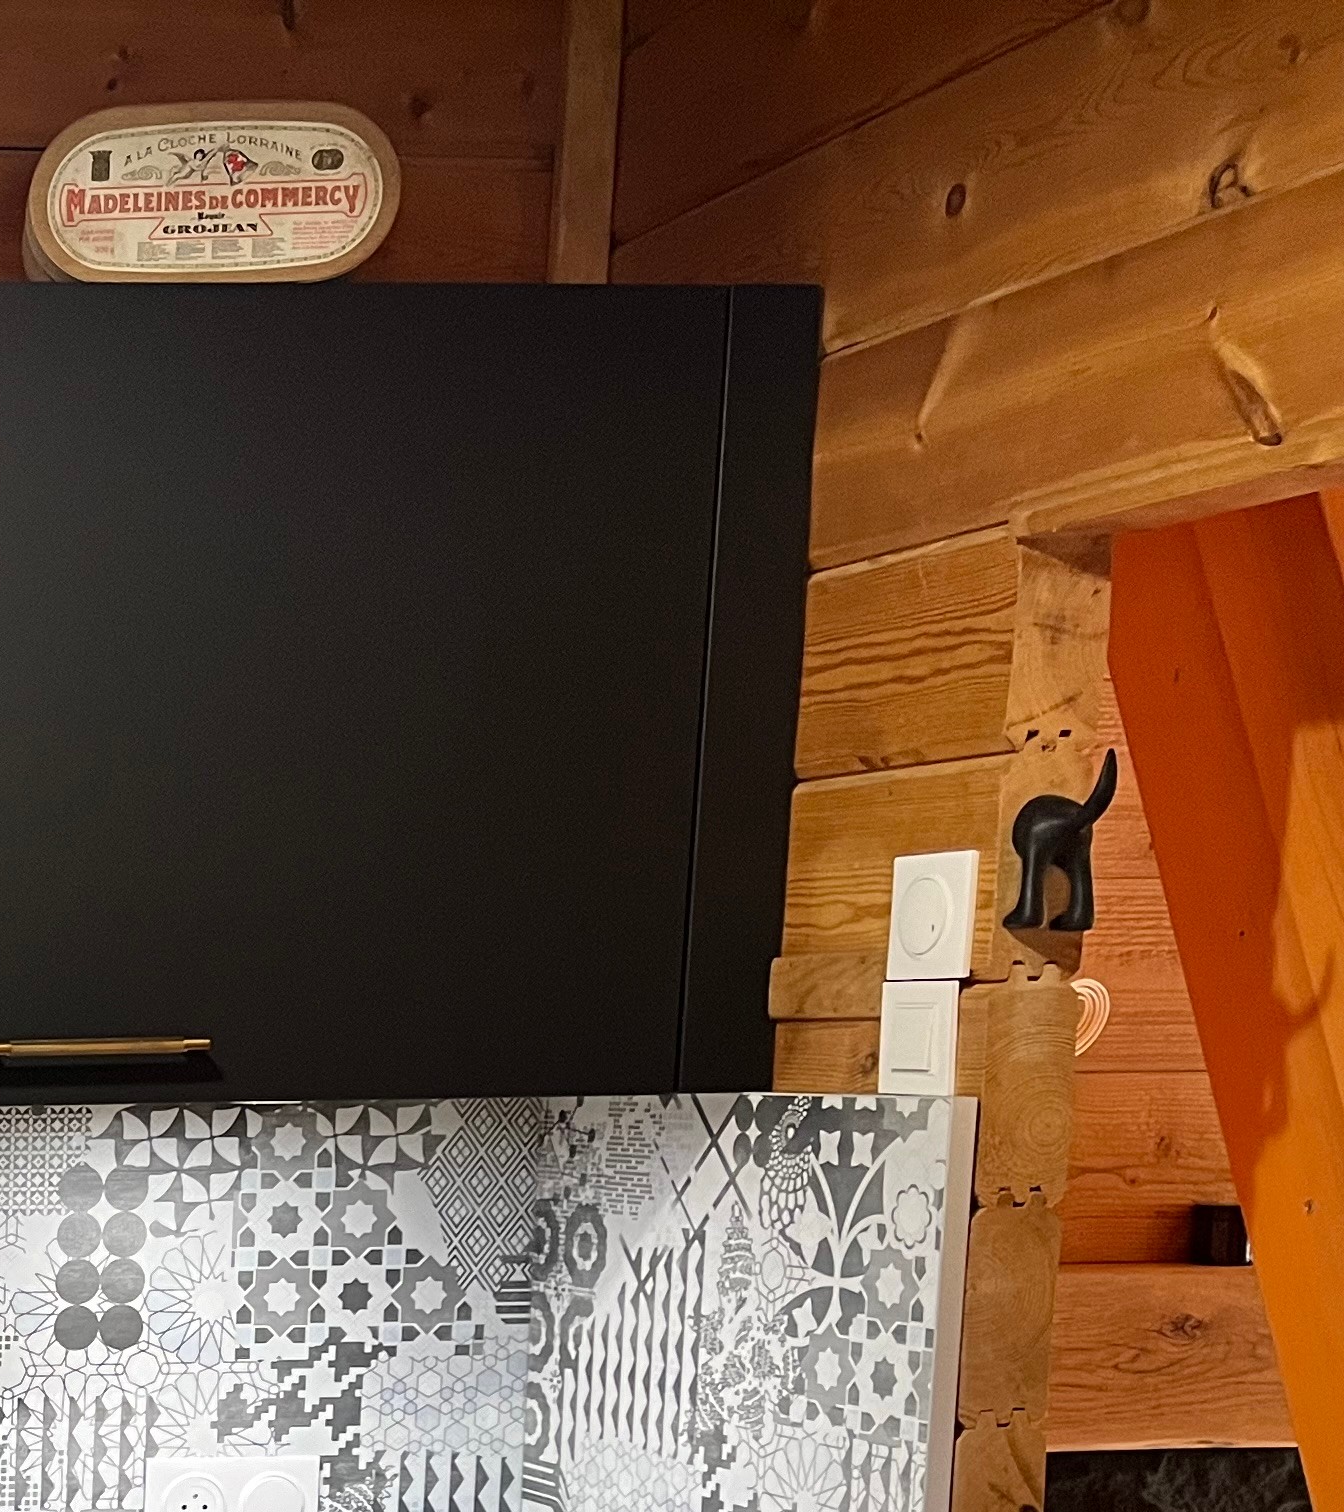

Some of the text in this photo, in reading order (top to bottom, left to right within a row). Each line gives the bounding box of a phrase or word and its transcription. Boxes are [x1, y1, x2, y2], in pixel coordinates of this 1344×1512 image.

[124, 131, 303, 167] A LA CLOCHE LORRAINE
[66, 188, 206, 222] MADELEINES
[231, 185, 360, 214] COMMERCY
[163, 223, 258, 235] GROJEAN
